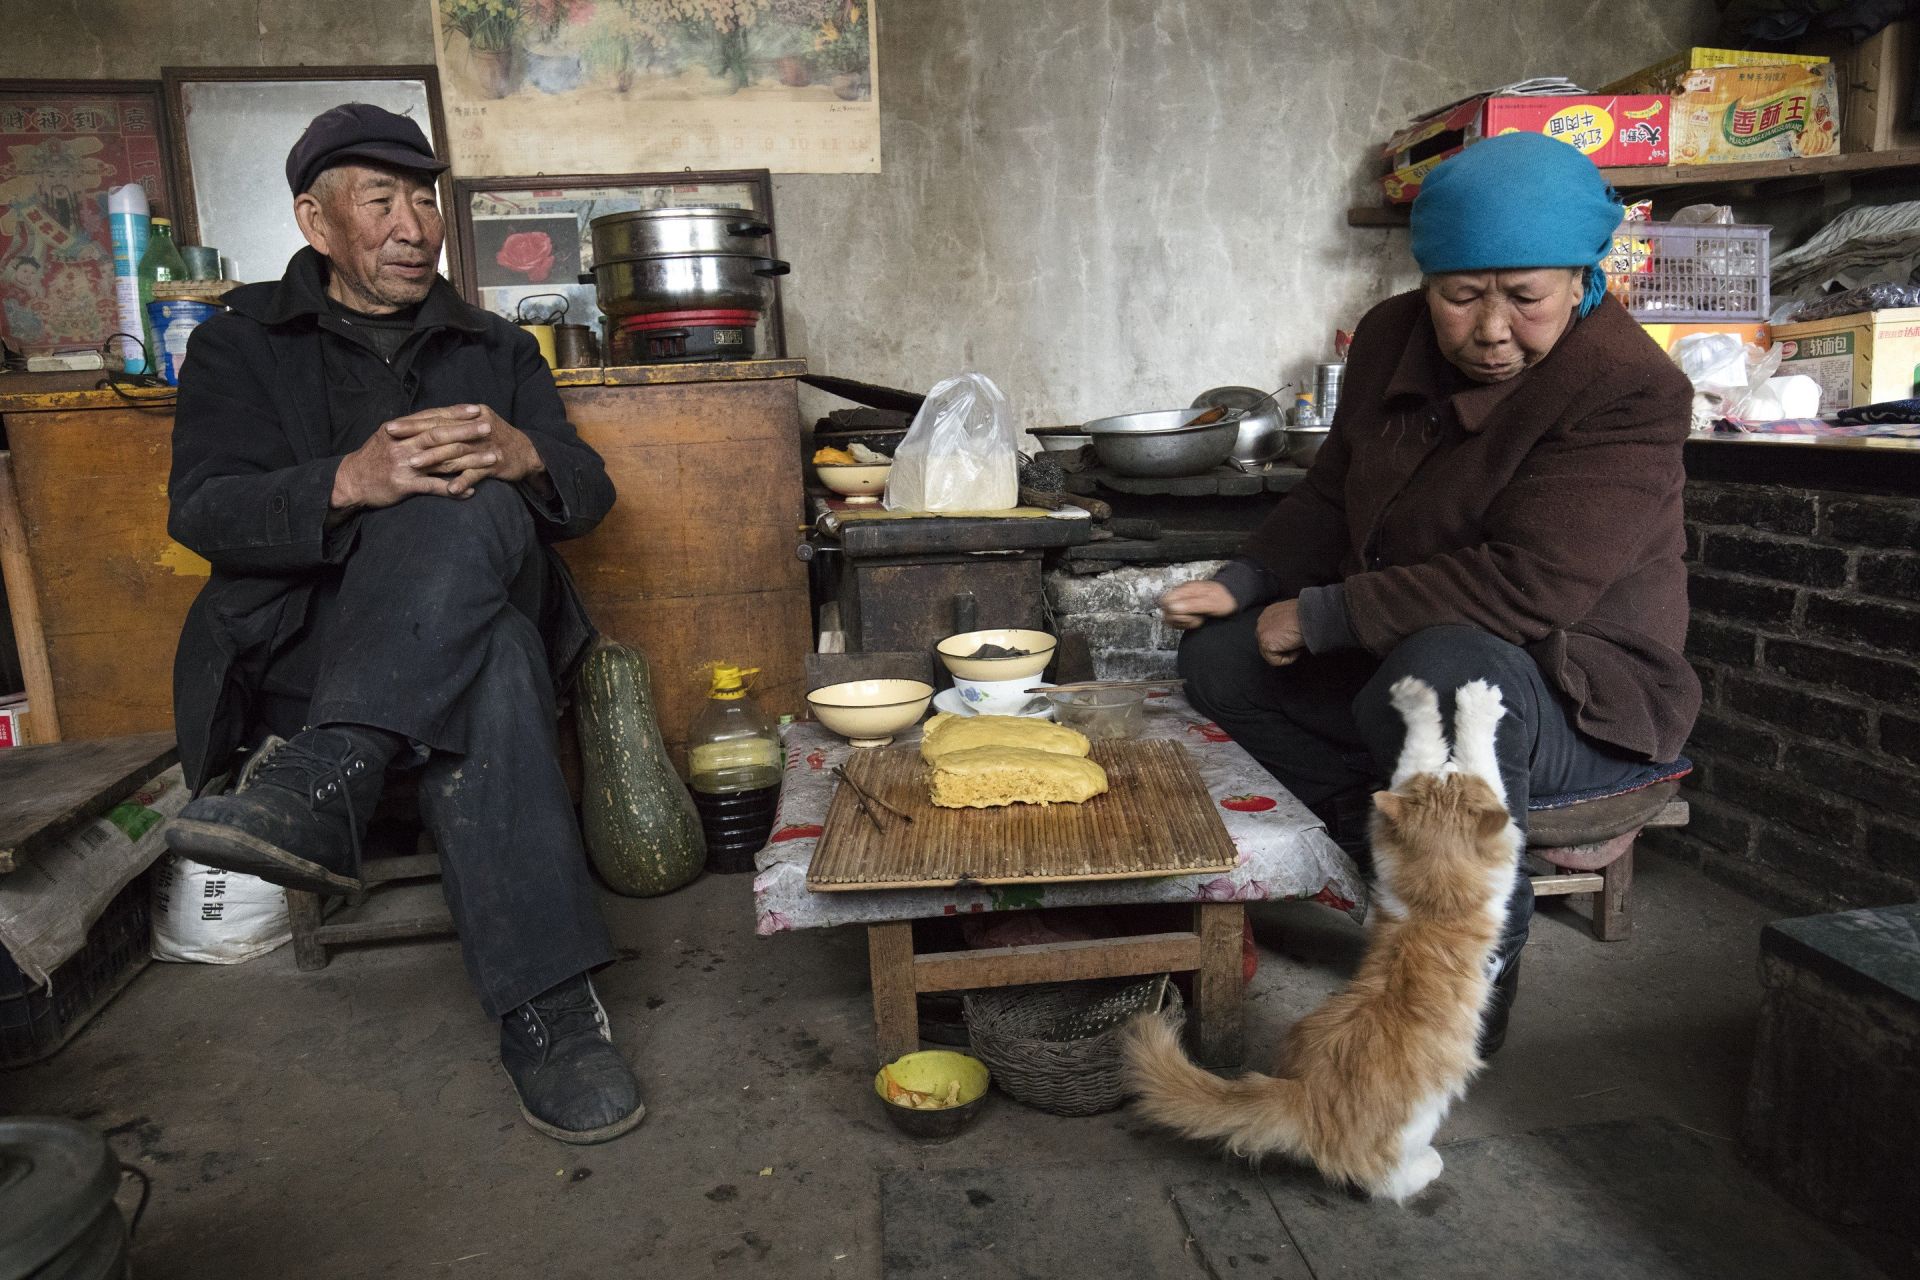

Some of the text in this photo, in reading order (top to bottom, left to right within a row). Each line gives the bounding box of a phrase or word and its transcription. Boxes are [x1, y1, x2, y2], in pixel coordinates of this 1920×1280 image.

[125, 107, 150, 132] 喜
[1549, 111, 1594, 136] 牛肉面
[1733, 96, 1807, 136] 香酥王
[1571, 128, 1602, 149] 红烧
[1627, 124, 1660, 146] 大今野
[1810, 335, 1847, 356] 软面包
